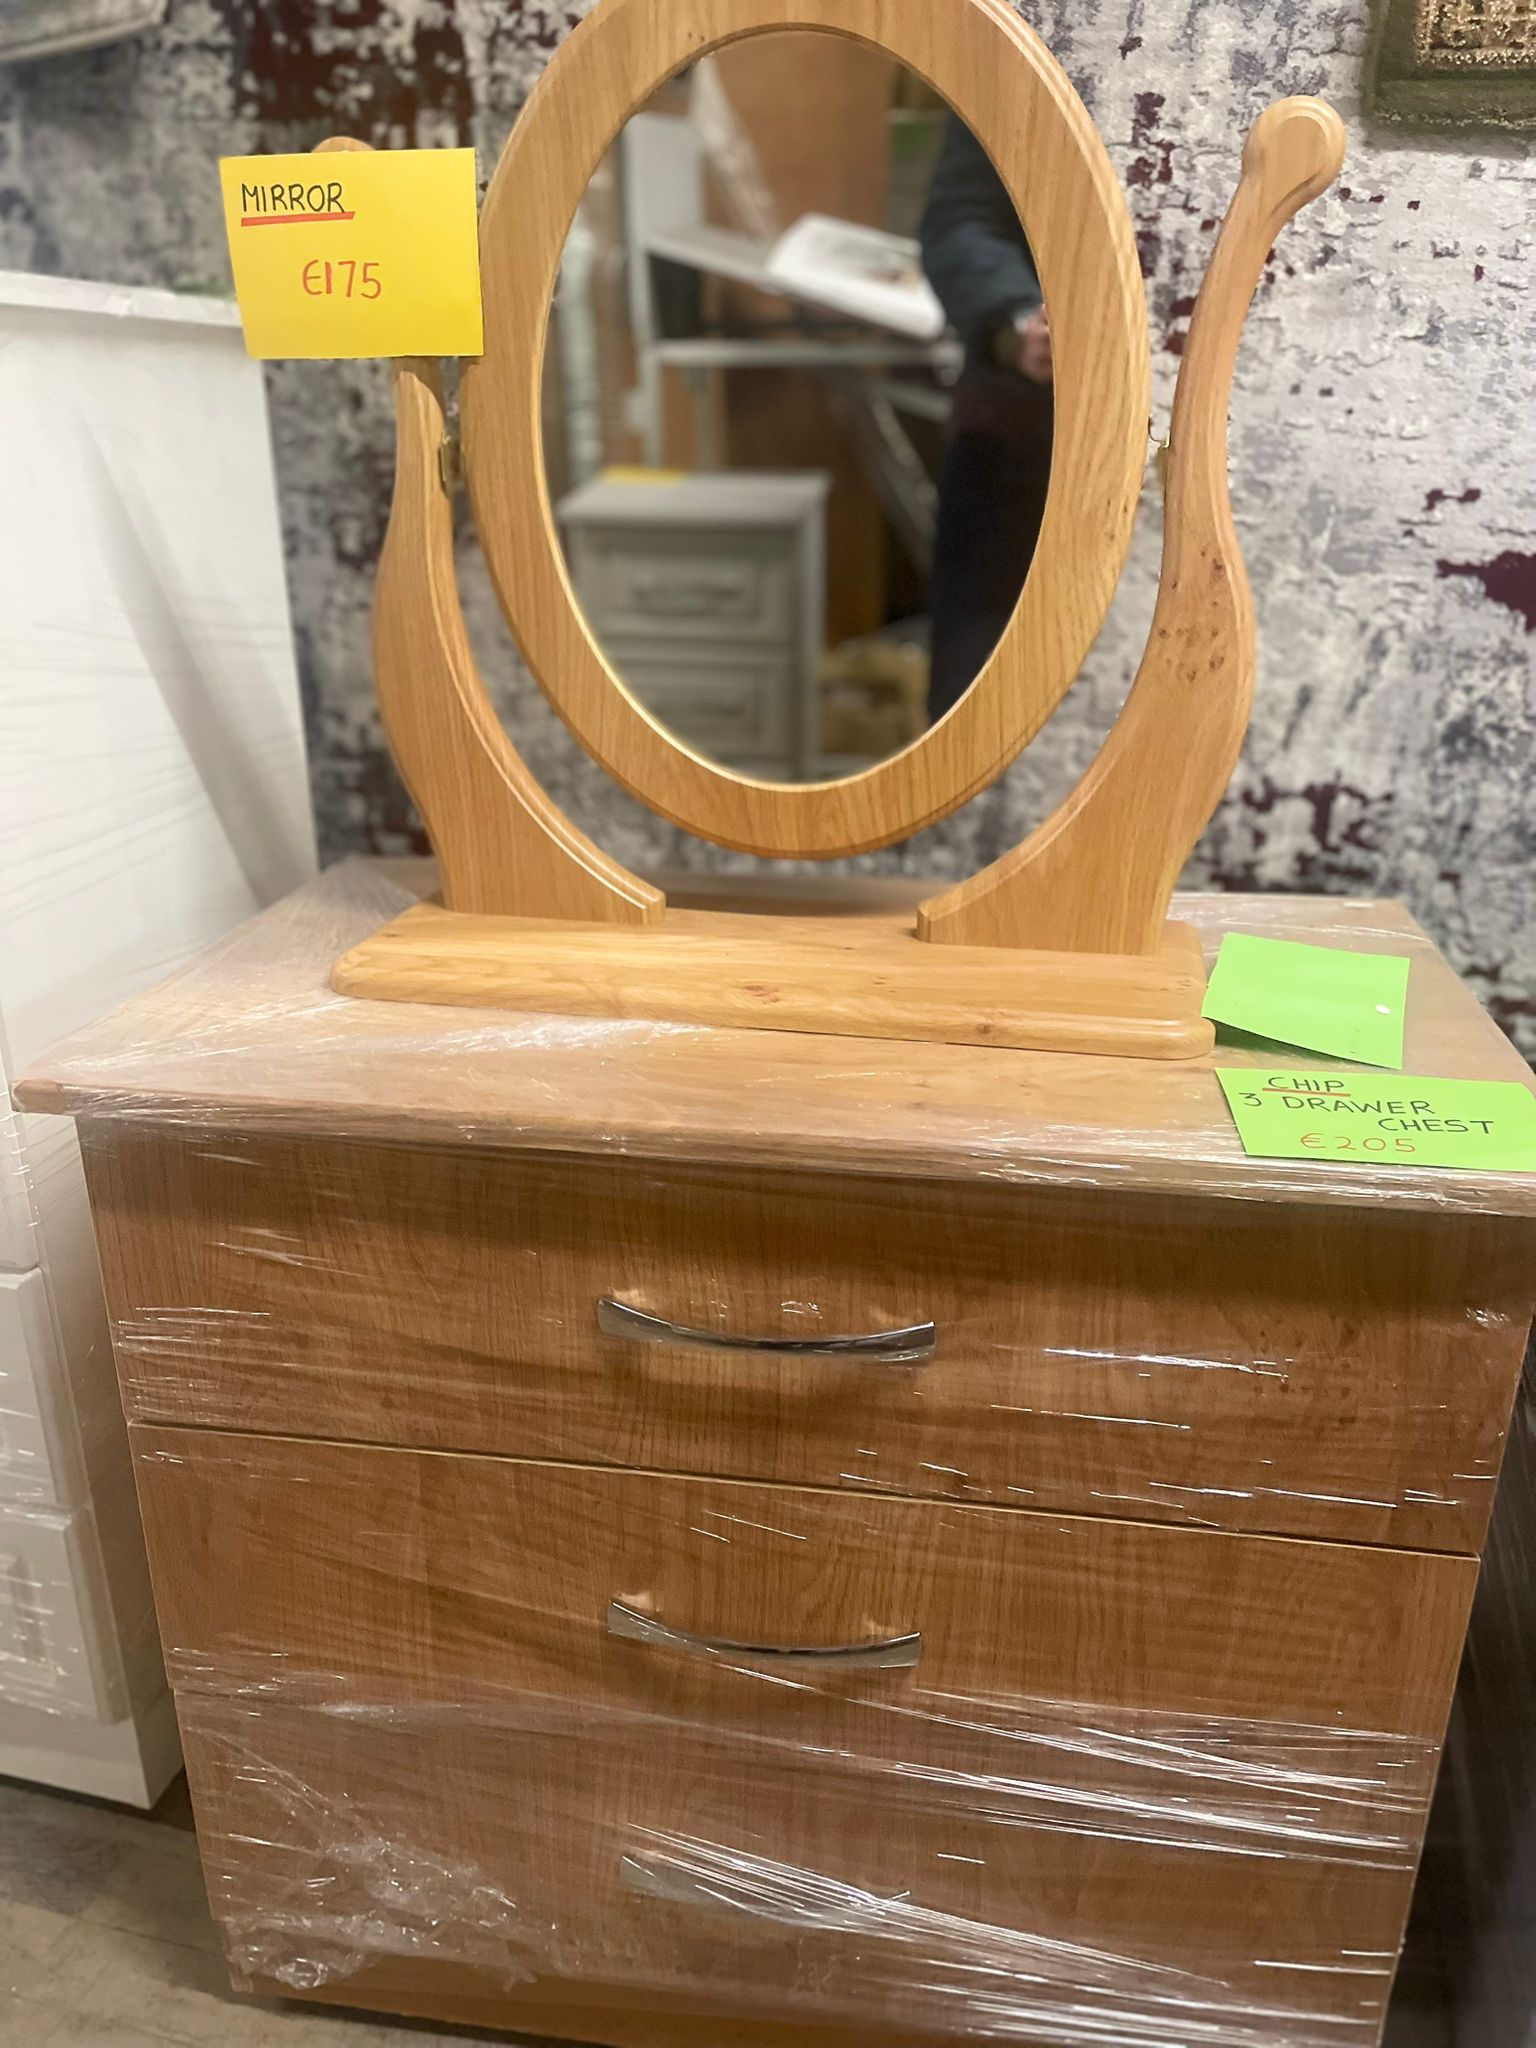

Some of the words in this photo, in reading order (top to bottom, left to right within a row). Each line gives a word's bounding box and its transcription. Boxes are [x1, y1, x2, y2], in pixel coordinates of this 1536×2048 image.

[241, 182, 345, 213] MIRROR
[1267, 1076, 1345, 1093] CHIP
[1238, 1092, 1263, 1107] 3
[1281, 1095, 1437, 1115] DRAWER
[1377, 1118, 1494, 1135] CHEST
[1300, 1132, 1416, 1153] €205
